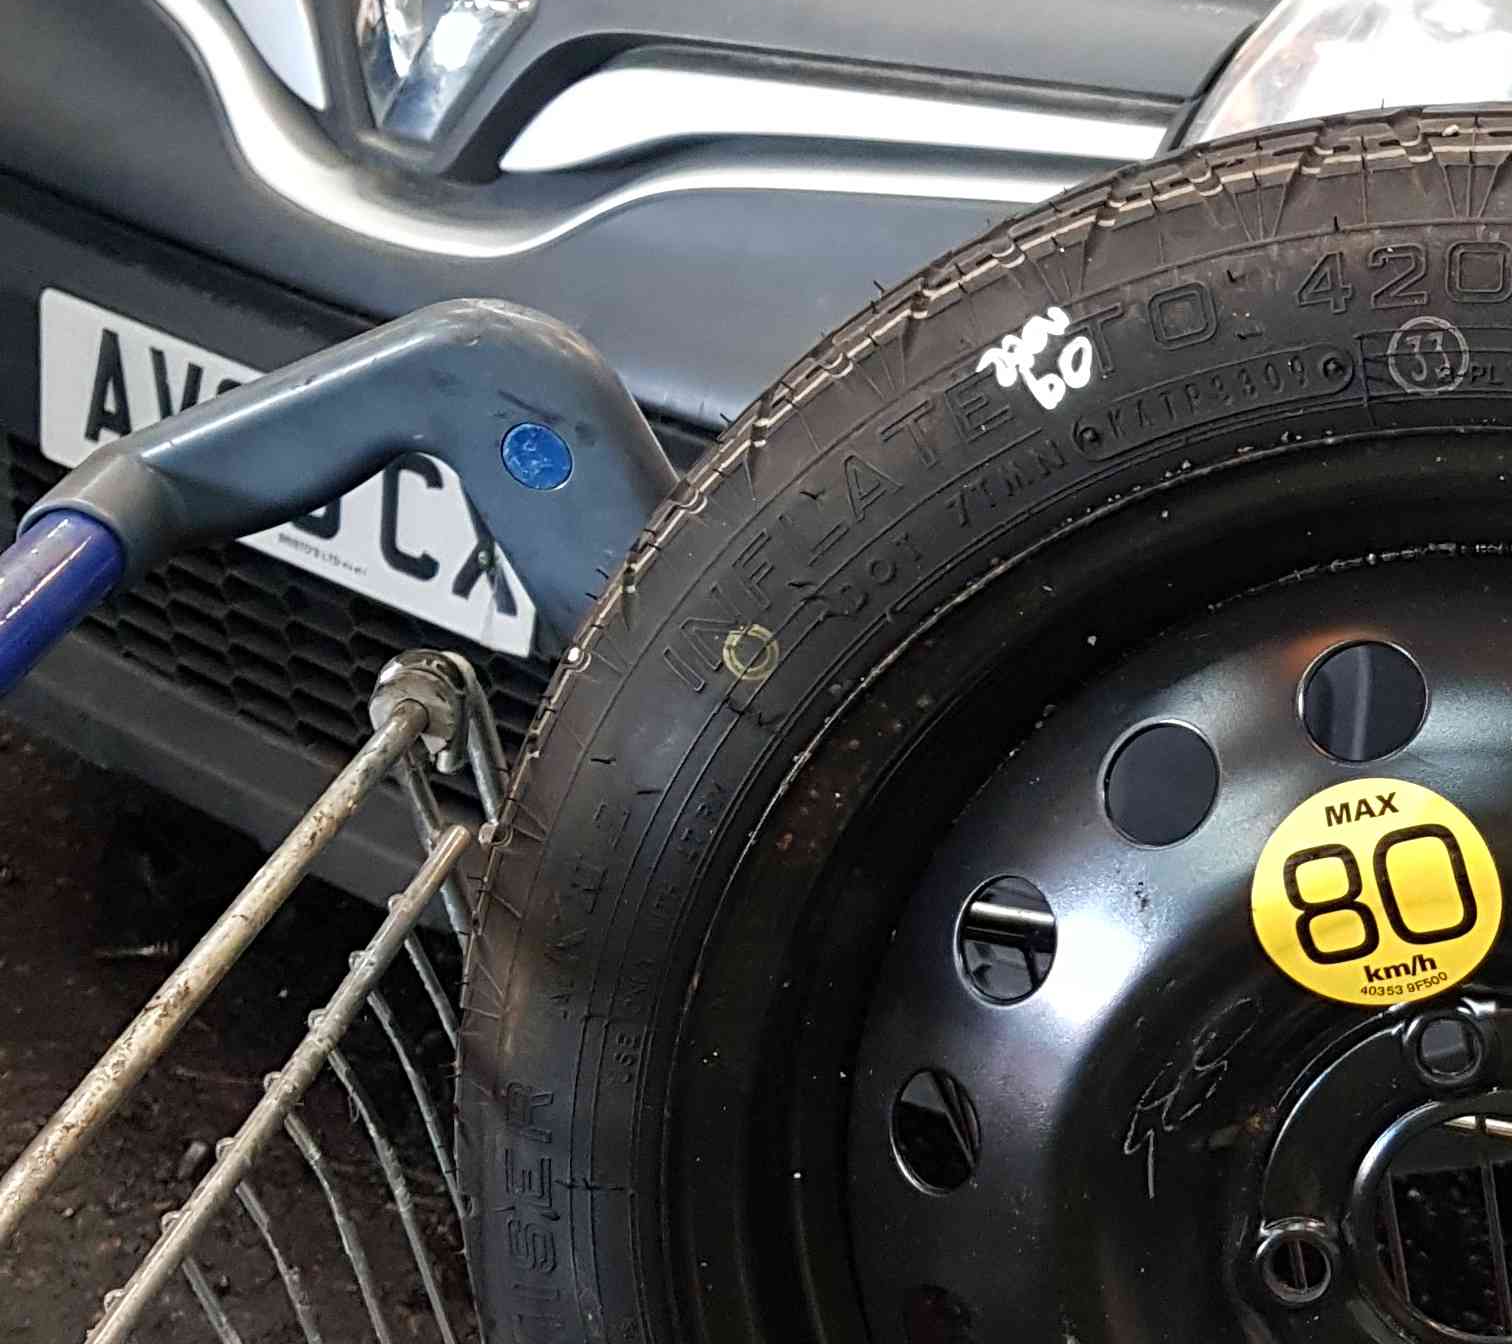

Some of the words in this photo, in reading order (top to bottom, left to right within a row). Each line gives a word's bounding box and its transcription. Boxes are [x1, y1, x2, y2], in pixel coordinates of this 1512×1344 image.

[660, 368, 1015, 692] INFLATE
[1065, 280, 1218, 375] TO
[1324, 791, 1400, 828] MAX
[1283, 823, 1477, 965] 80
[1363, 953, 1438, 983] km/h
